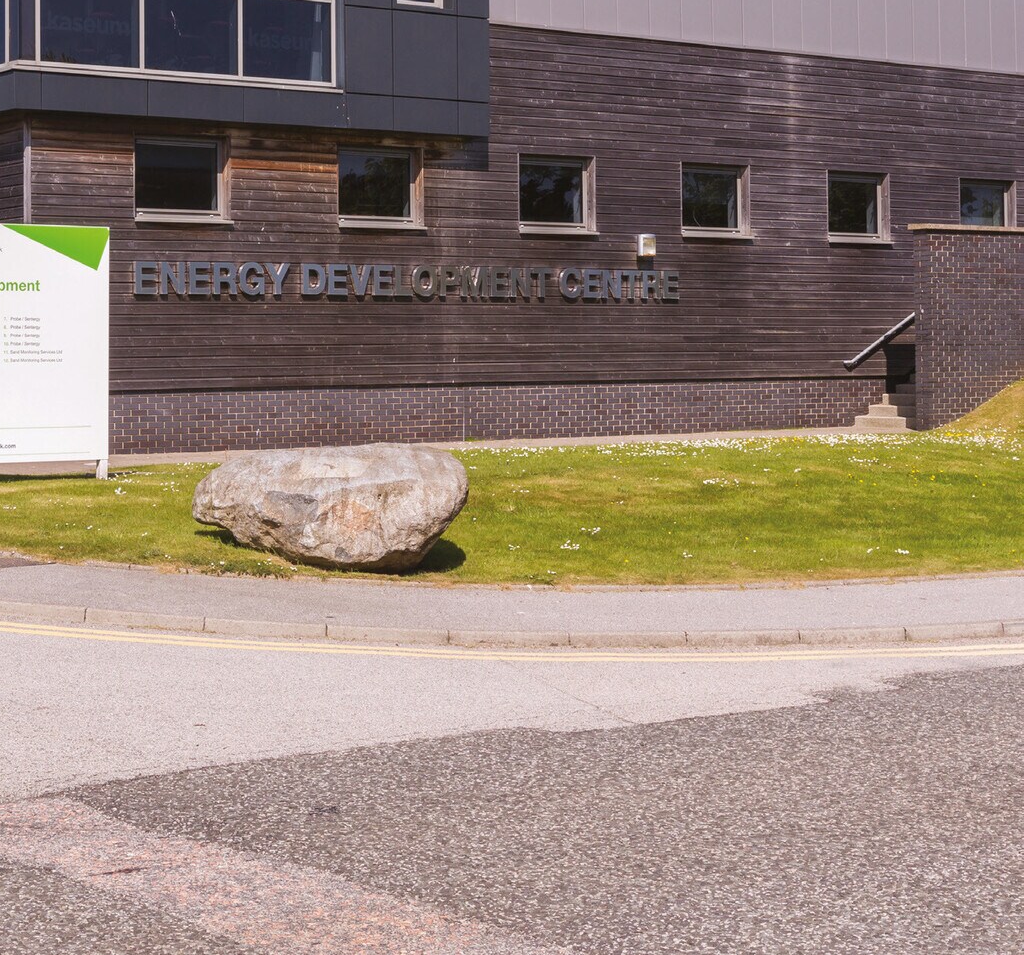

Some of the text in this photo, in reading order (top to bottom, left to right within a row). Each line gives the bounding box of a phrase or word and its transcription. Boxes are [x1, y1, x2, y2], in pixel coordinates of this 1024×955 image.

[134, 261, 680, 300] ENERGY DEVELOPMENT CENTRE
